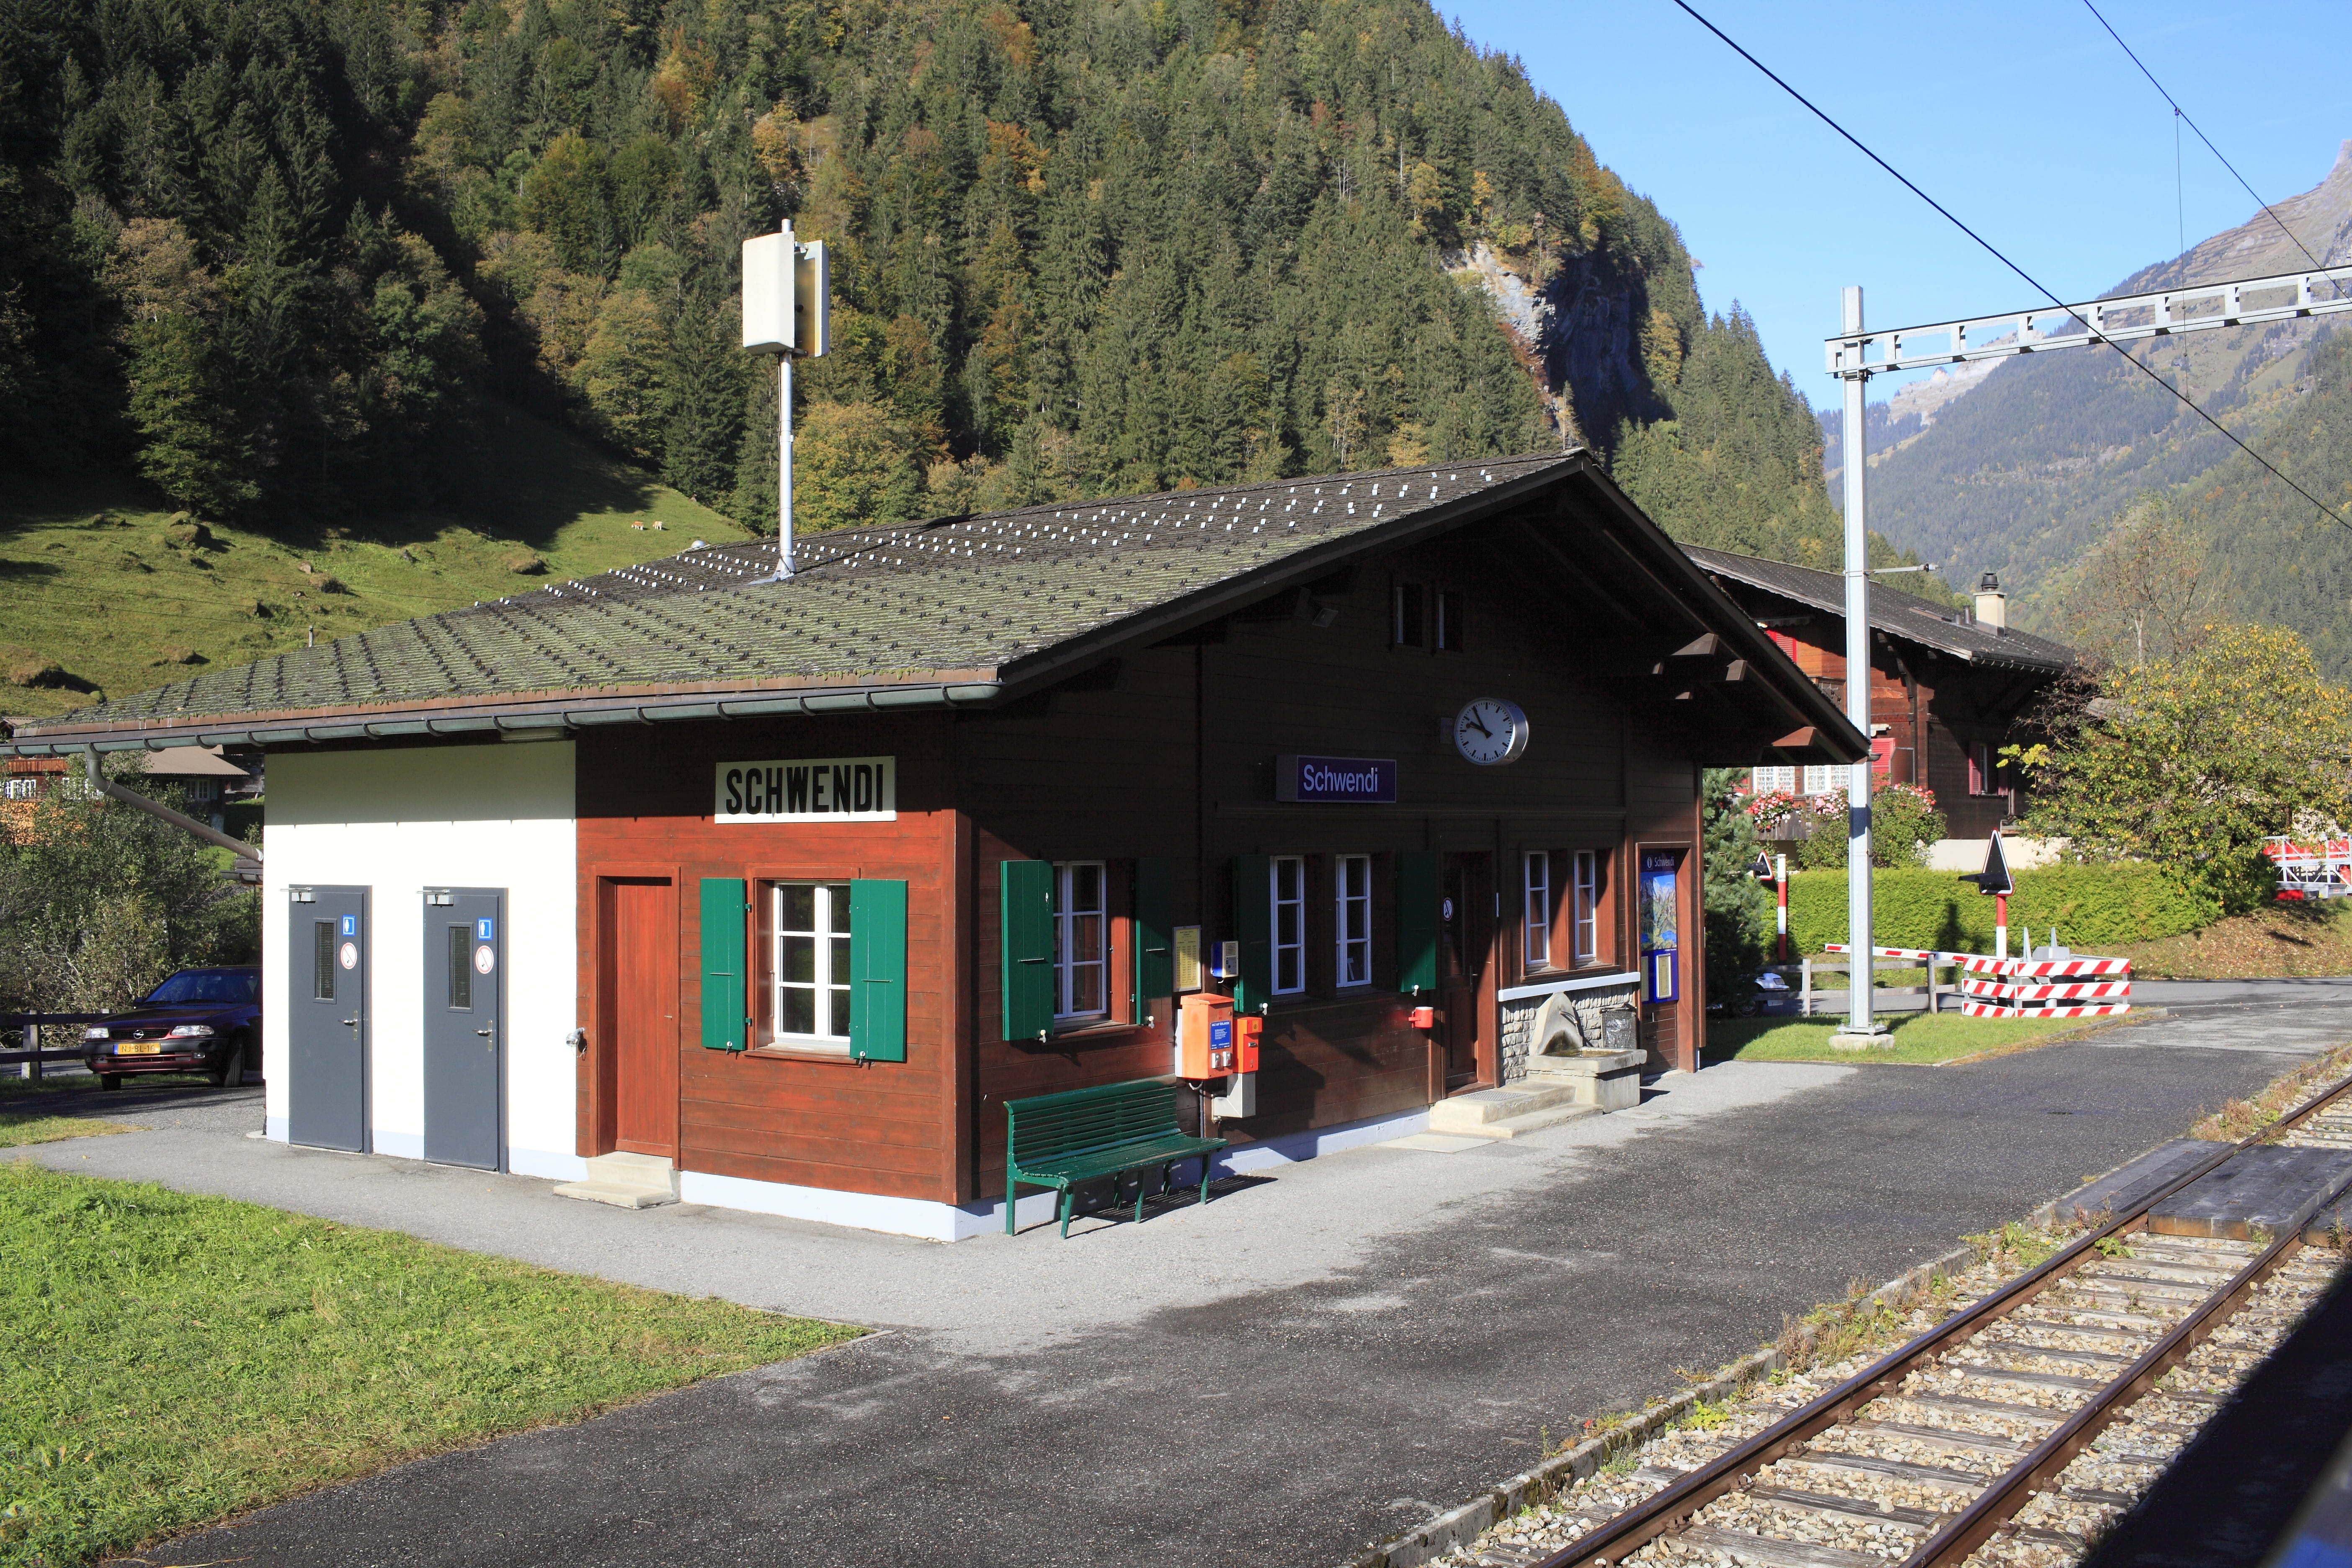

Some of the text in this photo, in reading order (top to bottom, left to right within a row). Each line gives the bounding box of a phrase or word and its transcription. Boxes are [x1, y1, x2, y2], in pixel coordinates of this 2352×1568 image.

[726, 764, 883, 815] SCHWENDI
[1303, 764, 1378, 792] Schwendi
[1654, 856, 1674, 867] Schwendi
